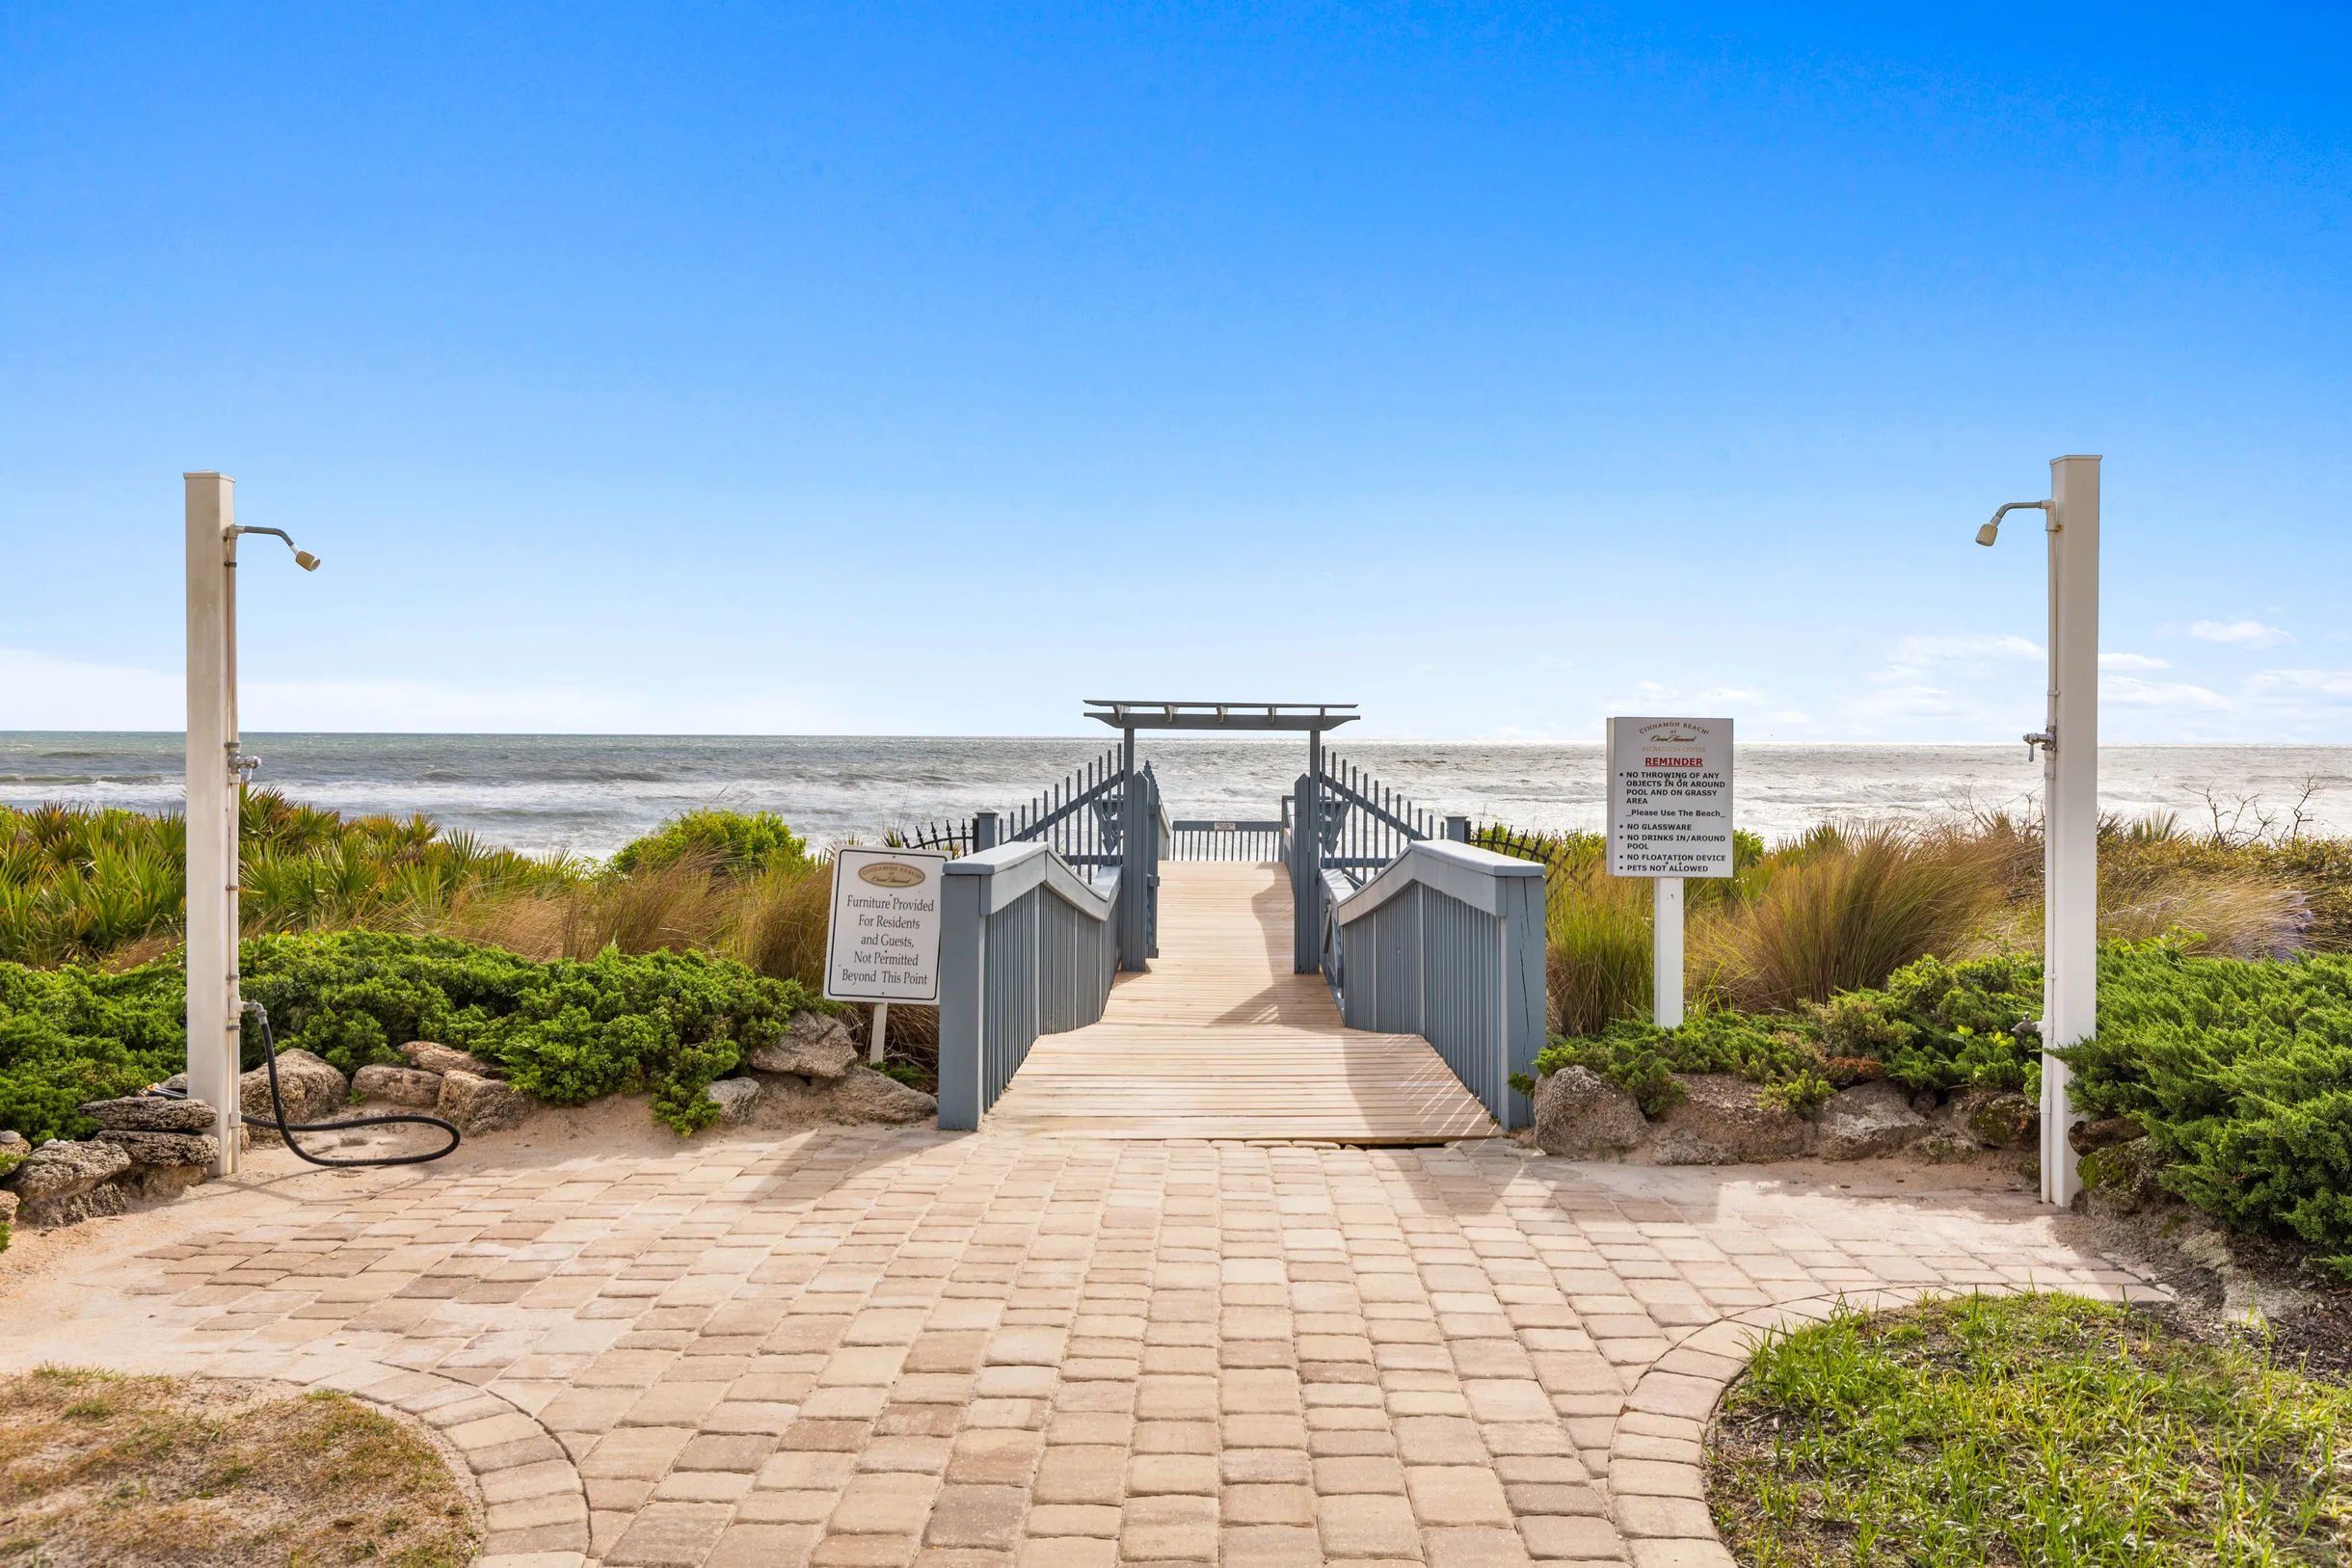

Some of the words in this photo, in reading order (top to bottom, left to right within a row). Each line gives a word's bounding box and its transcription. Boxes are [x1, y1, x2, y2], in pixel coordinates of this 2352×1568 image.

[1639, 721, 1680, 734] CINNAMON
[1645, 757, 1703, 767] REMINDER
[847, 895, 890, 909] Furniture
[893, 898, 934, 911] Provided
[858, 914, 874, 926] For
[876, 915, 920, 929] Residents
[861, 934, 878, 945] and
[881, 934, 914, 949] Guests,
[854, 951, 871, 963] Not
[874, 952, 918, 966] Permitted
[842, 969, 876, 985] Beyond
[882, 971, 901, 983] This
[903, 973, 928, 985] Point
